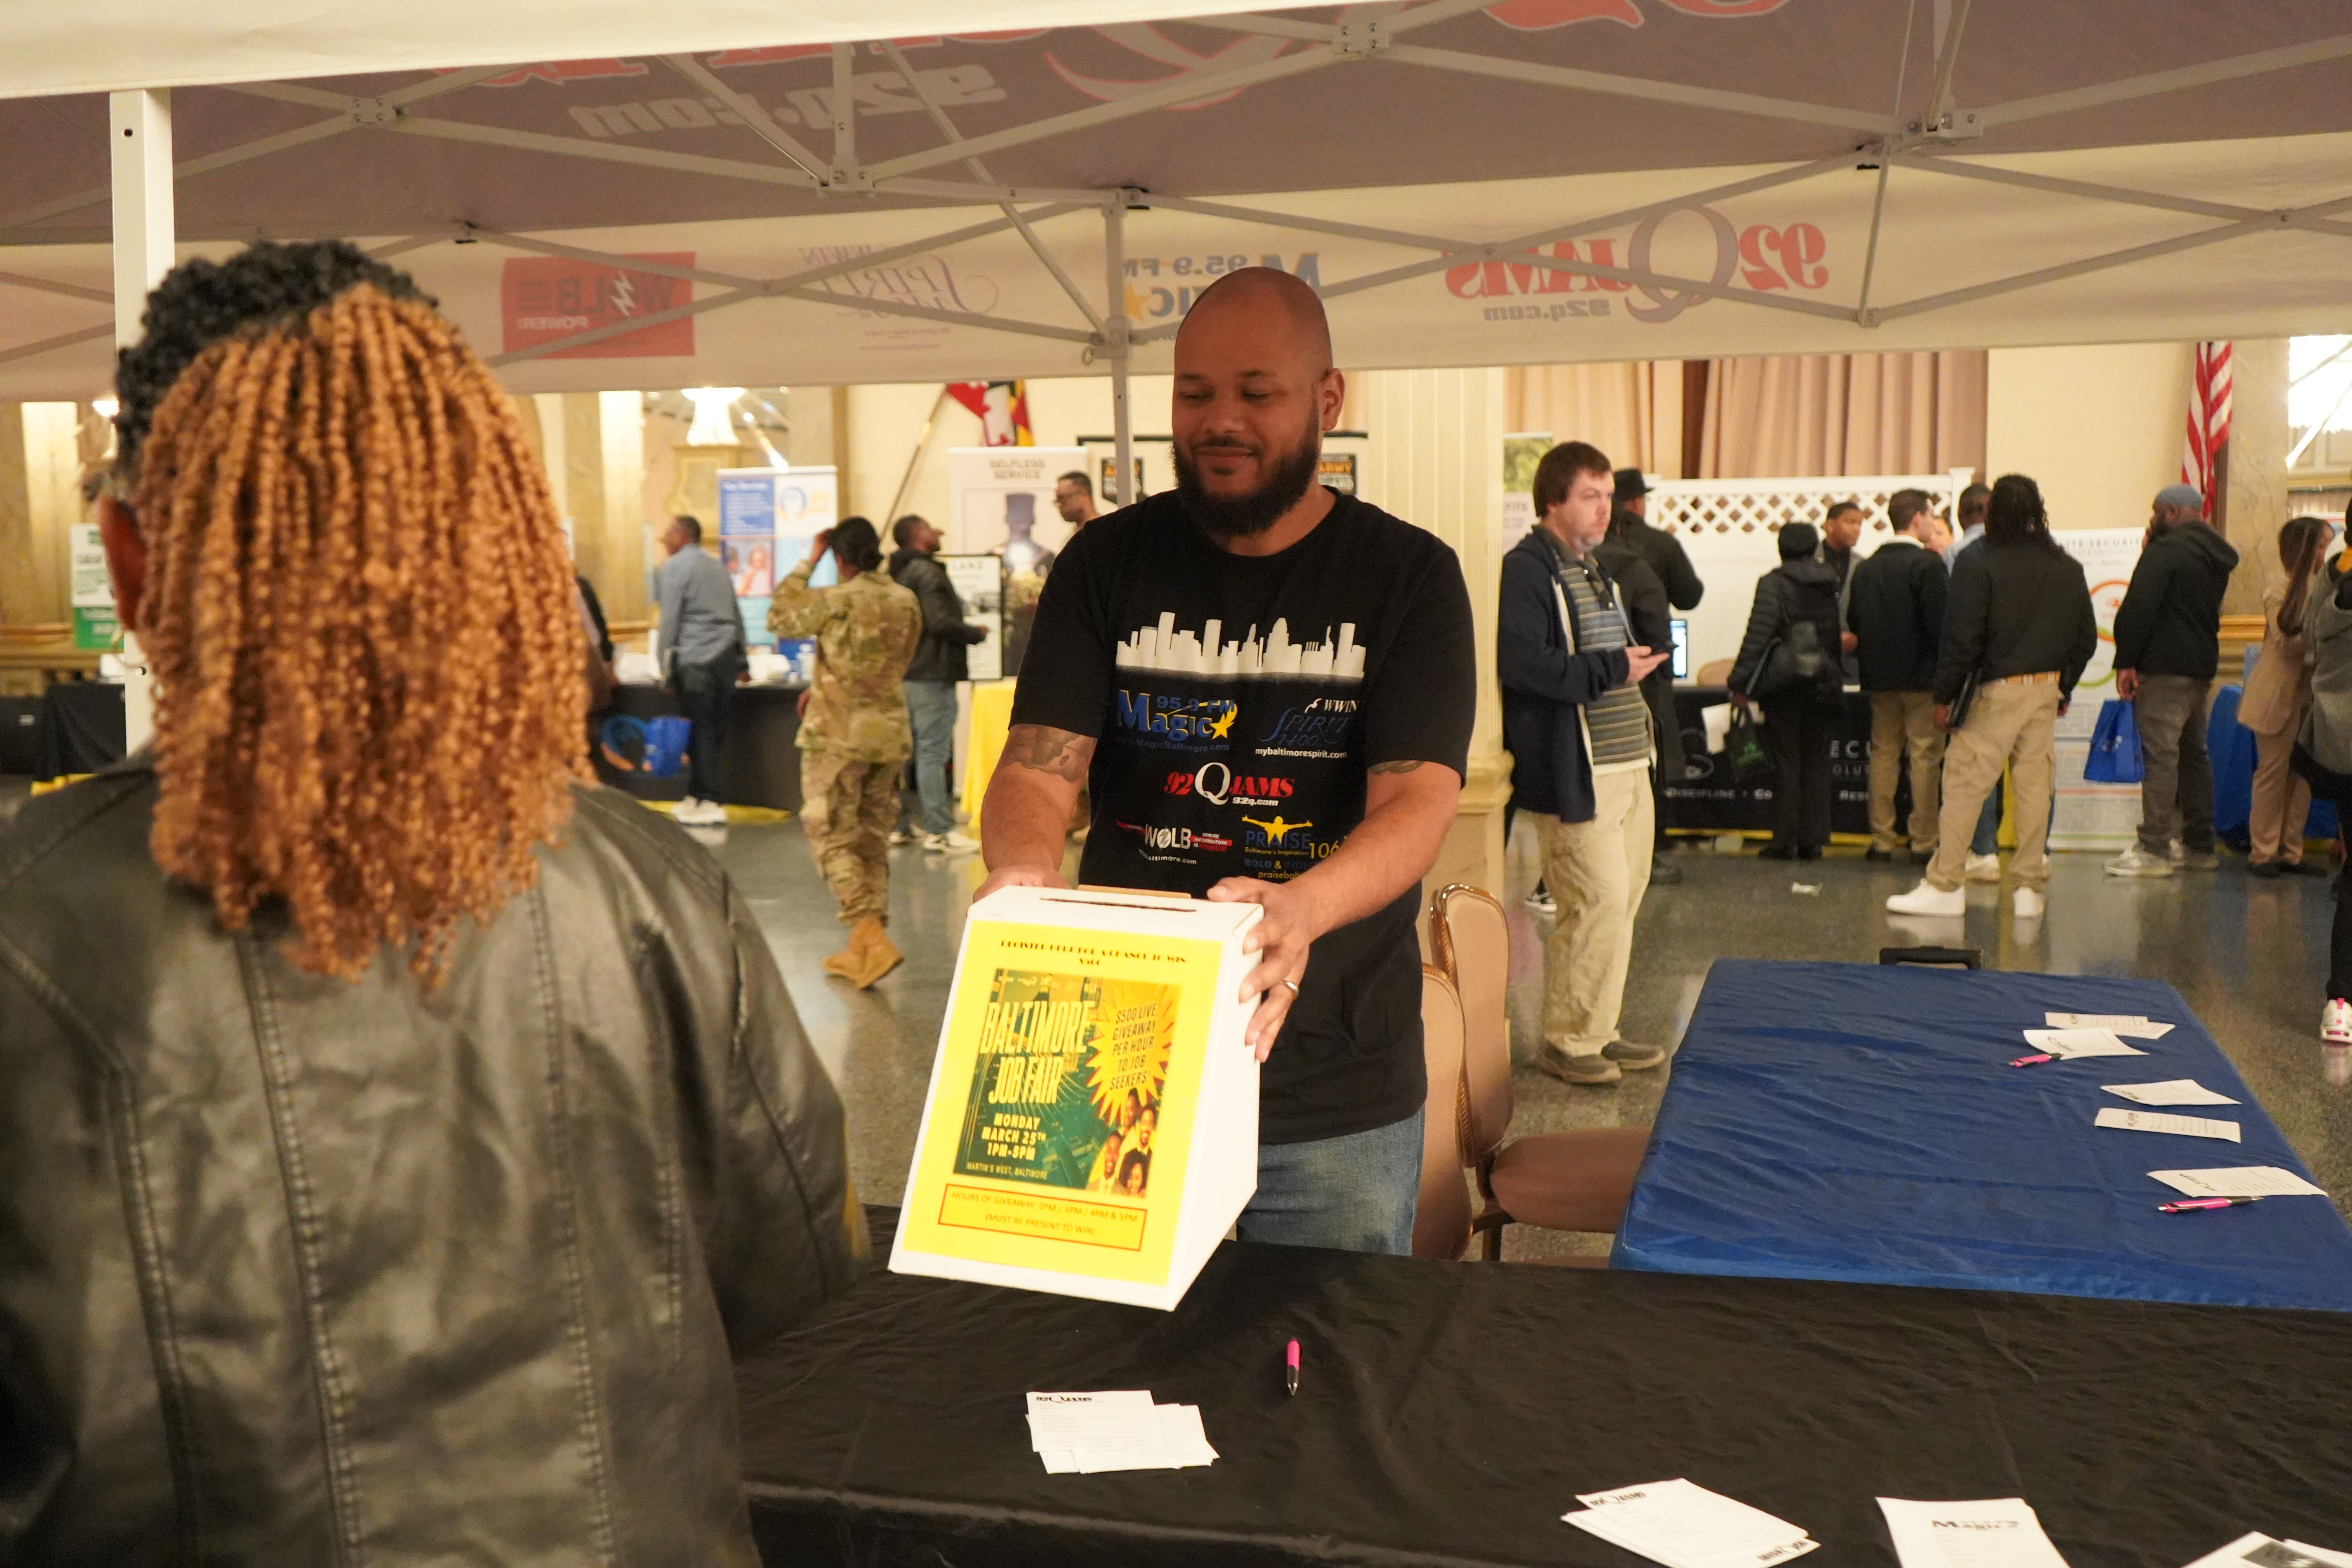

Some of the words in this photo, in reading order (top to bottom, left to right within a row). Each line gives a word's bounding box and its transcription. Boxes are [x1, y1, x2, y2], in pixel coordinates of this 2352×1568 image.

[2088, 537, 2141, 548] SECURIT
[1117, 689, 1213, 741] Magic
[1206, 700, 1234, 713] FM
[1324, 699, 1360, 713] WWIN
[1256, 707, 1354, 744] SPIRIT
[1255, 747, 1347, 759] mybaltimorespirit.com
[1232, 797, 1279, 806] 92q.com
[1145, 824, 1191, 849] WOLB
[1194, 837, 1227, 846] INFORMATION
[1243, 830, 1311, 849] PRAISE
[1245, 847, 1276, 855] Baltimore's
[1274, 860, 1282, 869] &
[1115, 1007, 1139, 1024] $500
[1138, 1002, 1158, 1020] LIVE
[980, 1001, 1096, 1054] BALTIMORE
[1112, 1020, 1158, 1040] GIVEAWAY
[1112, 1041, 1129, 1057] PER
[1130, 1035, 1154, 1053] HOUR
[1118, 1058, 1129, 1072] TO
[1128, 1055, 1146, 1071] JOB
[988, 1056, 1026, 1104] JOB
[1022, 1056, 1064, 1104] FAIR
[1110, 1070, 1151, 1091] SEEKERS!
[994, 1112, 1040, 1131] MONDAY
[981, 1127, 1020, 1143] MARCH
[987, 1142, 1036, 1161] 1PM-5PM
[967, 1161, 995, 1173] MARTIN'S
[1015, 1169, 1047, 1180] BALTIMORE
[952, 1191, 980, 1202] HOURS
[981, 1194, 992, 1203] OF
[994, 1196, 1037, 1209] GIVEAWAY:
[1038, 1202, 1056, 1211] 2PM
[1064, 1205, 1082, 1215] 3PM
[1090, 1209, 1108, 1219] 4PM
[1110, 1211, 1116, 1220] &
[1120, 1213, 1138, 1223] 5PM
[985, 1213, 1011, 1224] (MUST
[1013, 1217, 1023, 1225] BE
[1025, 1219, 1060, 1230] PRESENT
[1062, 1223, 1073, 1232] TO
[1075, 1225, 1095, 1236] WIN)
